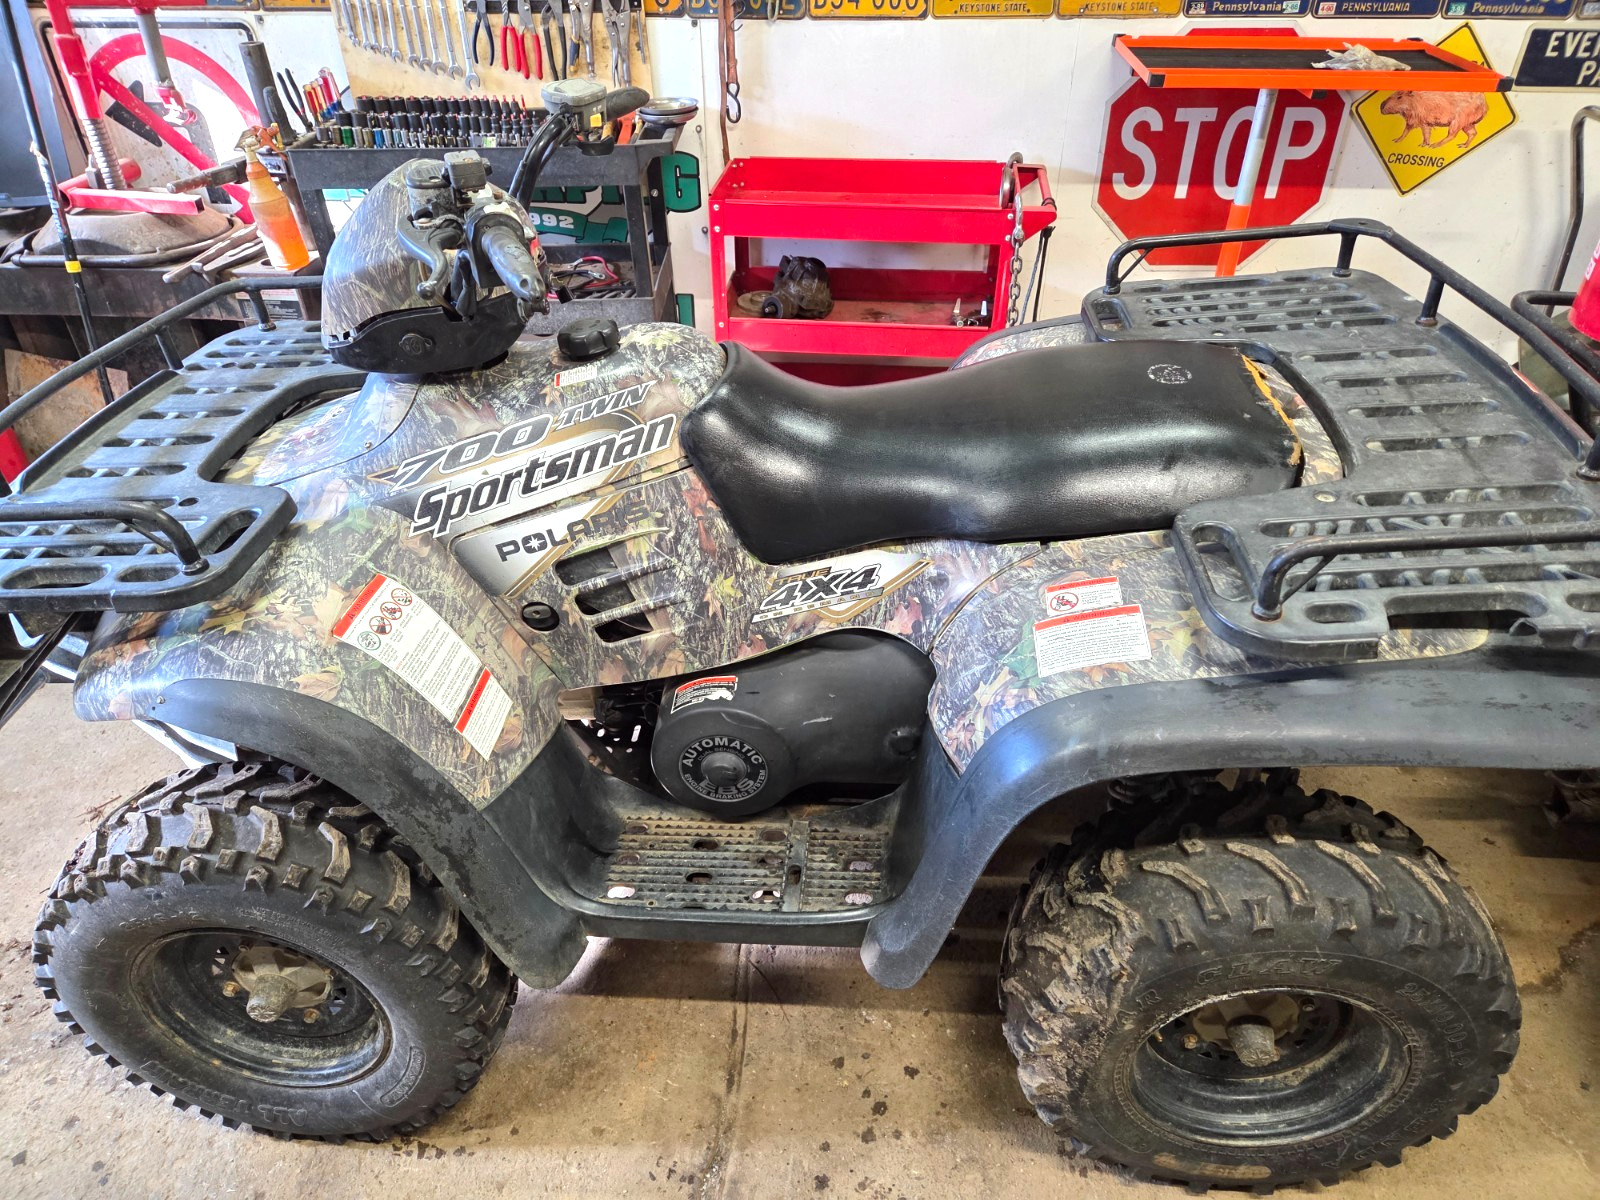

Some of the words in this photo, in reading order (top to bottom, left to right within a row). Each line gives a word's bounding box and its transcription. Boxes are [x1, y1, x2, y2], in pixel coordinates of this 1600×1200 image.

[960, 4, 1000, 12] KEYSTONE
[1004, 3, 1027, 12] STATE
[1084, 3, 1127, 12] KEYSTONE
[1131, 2, 1153, 11] STATE
[1212, 1, 1282, 12] Pennsylvania
[1341, 3, 1410, 11] PENNSYLVANIA
[1472, 3, 1545, 14] Pennsylvania
[1112, 107, 1326, 201] STOP
[1388, 153, 1445, 168] CROSSING
[389, 414, 552, 493] 700
[554, 381, 657, 431] TWIN
[409, 414, 676, 538] Sportsman
[496, 499, 650, 562] POLARIS
[682, 737, 762, 767] AUTOMATIC
[684, 773, 708, 795] ENGINE
[709, 791, 748, 799] BRAKING
[748, 769, 766, 793] SYSTEM
[699, 778, 754, 795] EBS
[1198, 958, 1343, 985] CLAW
